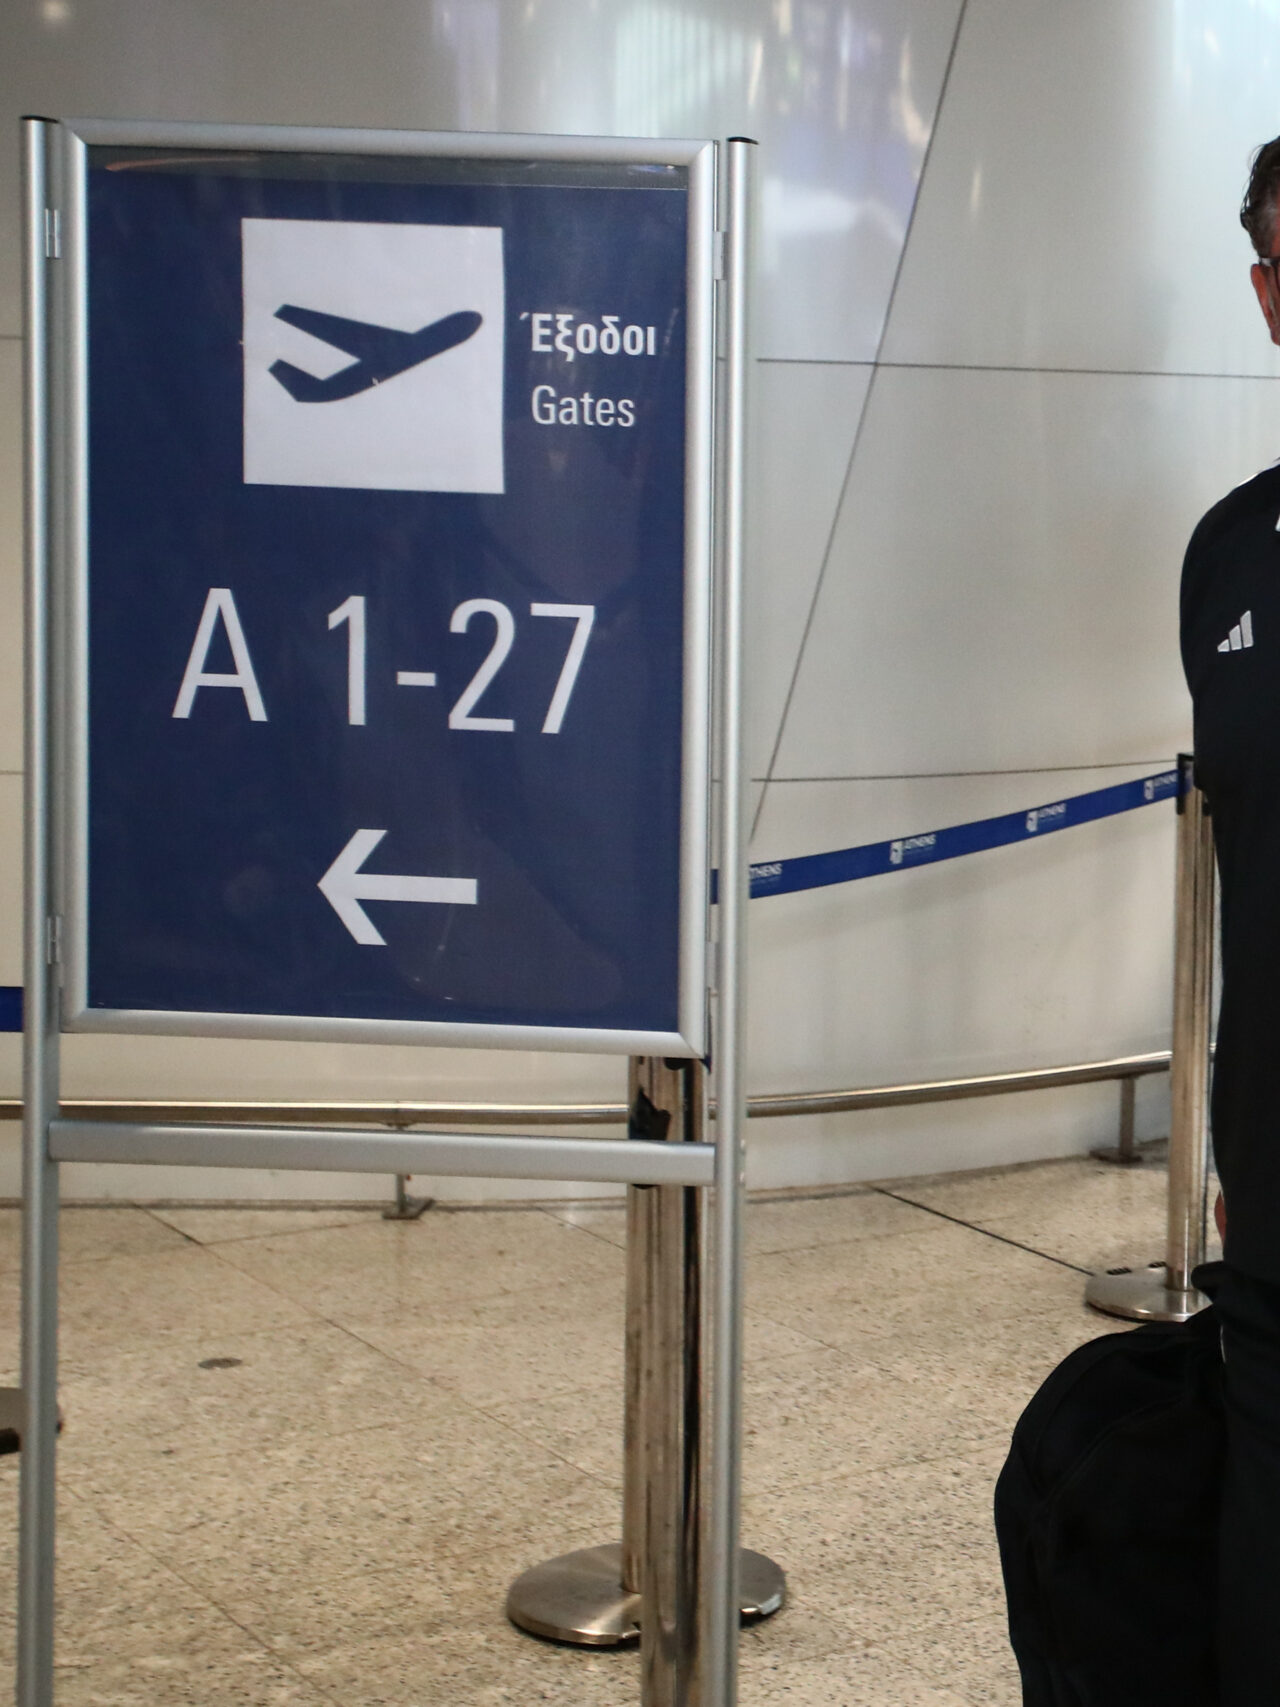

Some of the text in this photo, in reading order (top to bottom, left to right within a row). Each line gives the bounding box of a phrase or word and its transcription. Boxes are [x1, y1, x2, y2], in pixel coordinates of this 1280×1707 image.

[519, 312, 657, 362] Έξοδοι
[531, 384, 636, 428] Gates
[171, 587, 596, 735] A 1-27
[748, 863, 783, 879] THENS
